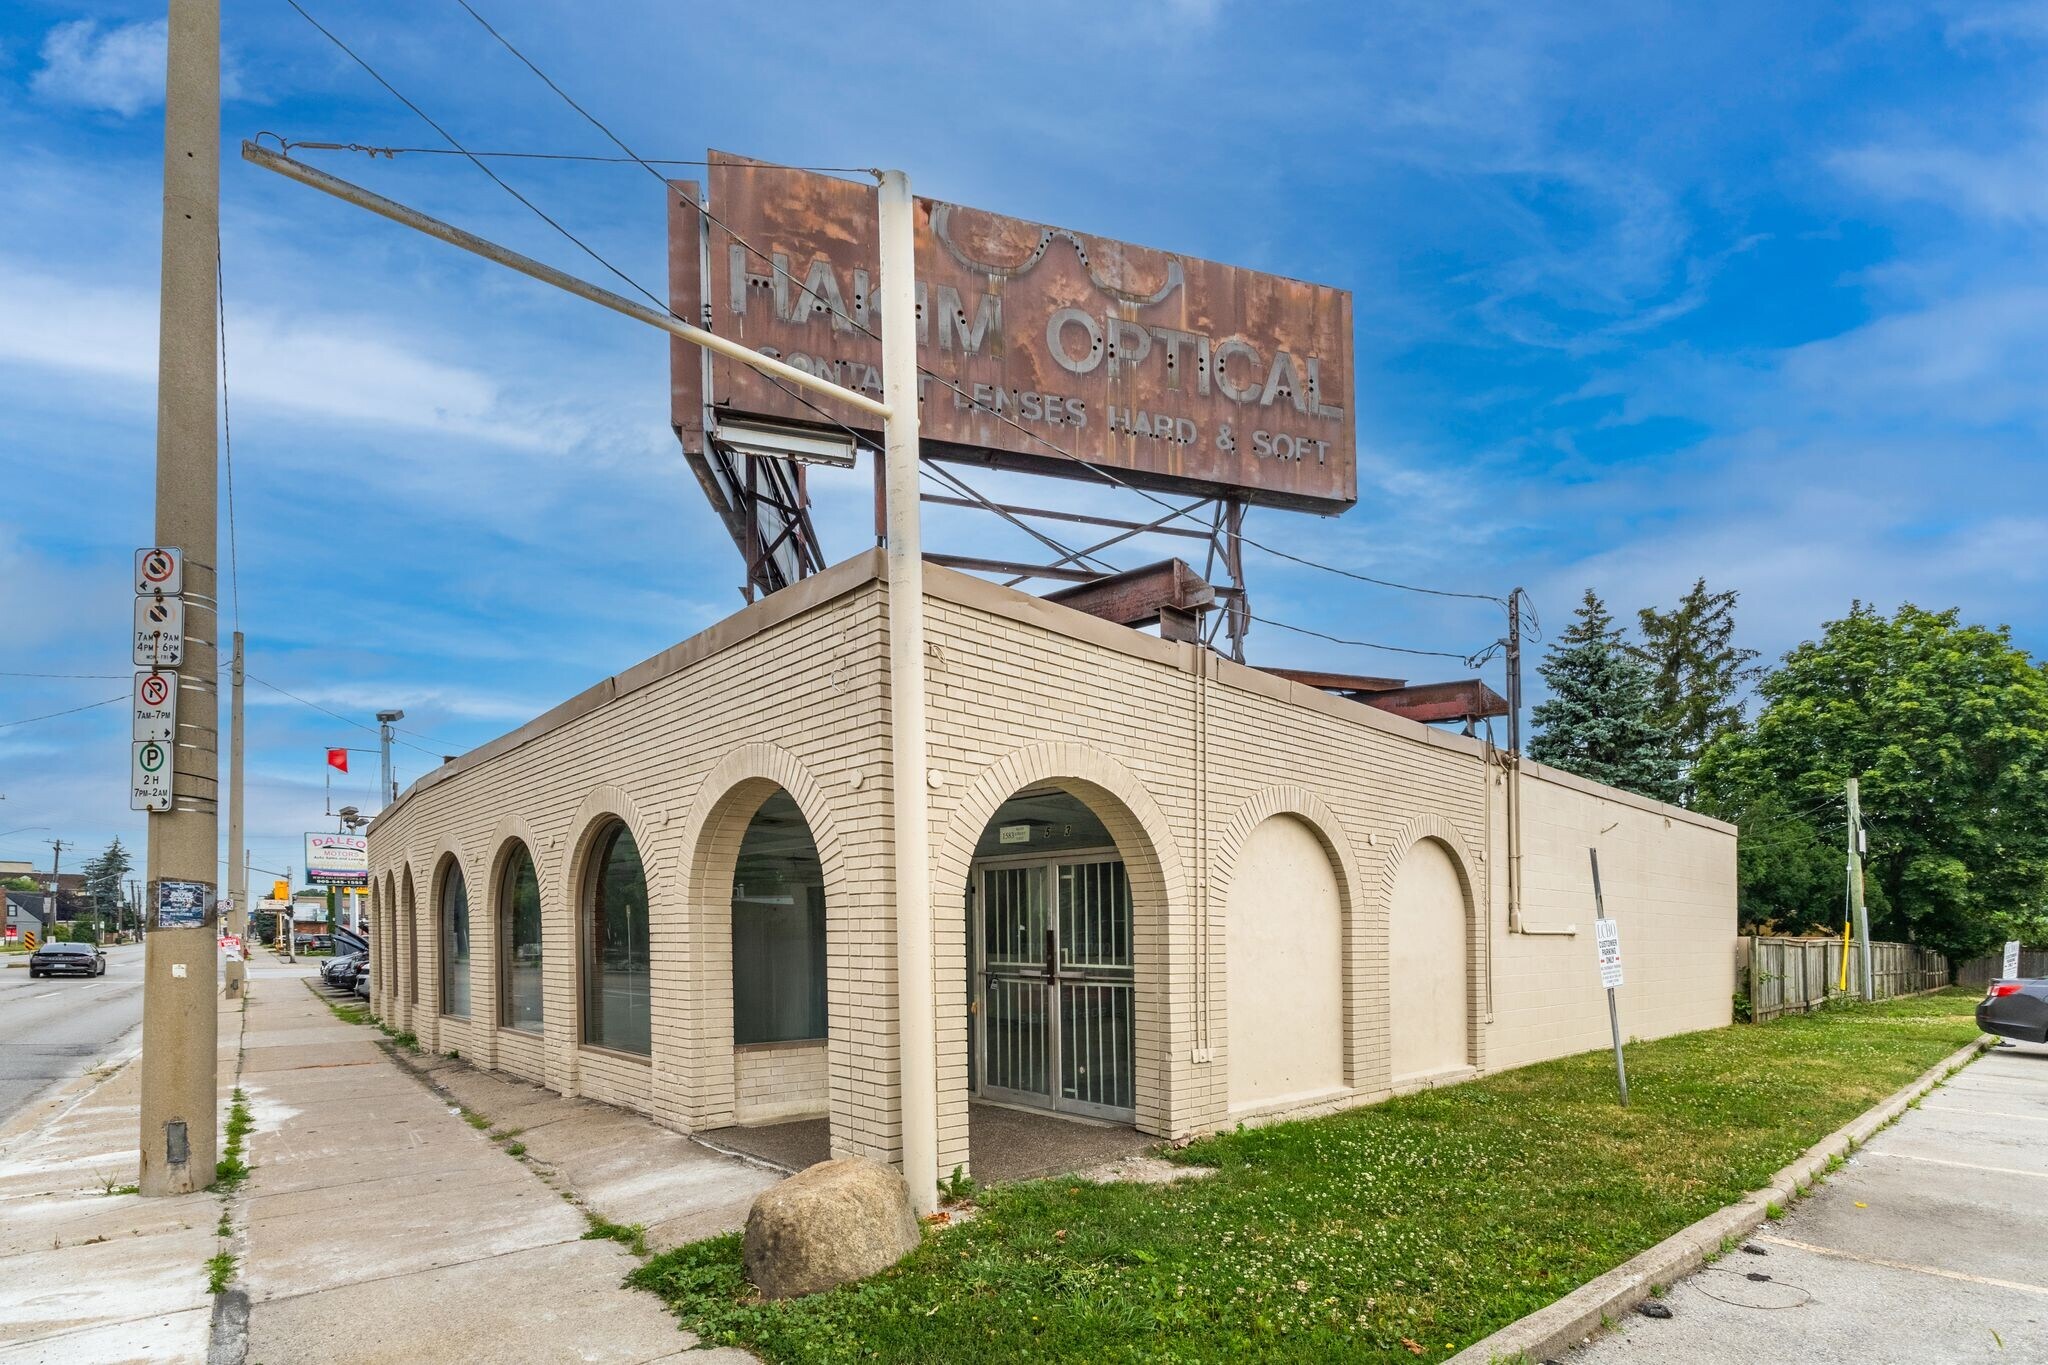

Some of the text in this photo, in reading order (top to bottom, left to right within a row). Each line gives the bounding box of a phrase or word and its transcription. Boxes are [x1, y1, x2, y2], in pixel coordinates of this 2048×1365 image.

[729, 244, 1344, 420] HAKIM OPTICAL
[754, 346, 1331, 467] CONTAT LENSES HARD & SOFT
[162, 632, 179, 641] 9AM
[137, 643, 179, 652] 4PM 6PM
[137, 710, 171, 720] 7AM-7PM
[143, 775, 159, 785] 2 H
[134, 788, 168, 797] 7PM-2AM
[1045, 825, 1071, 838] 5 3
[312, 836, 367, 849] DALEO
